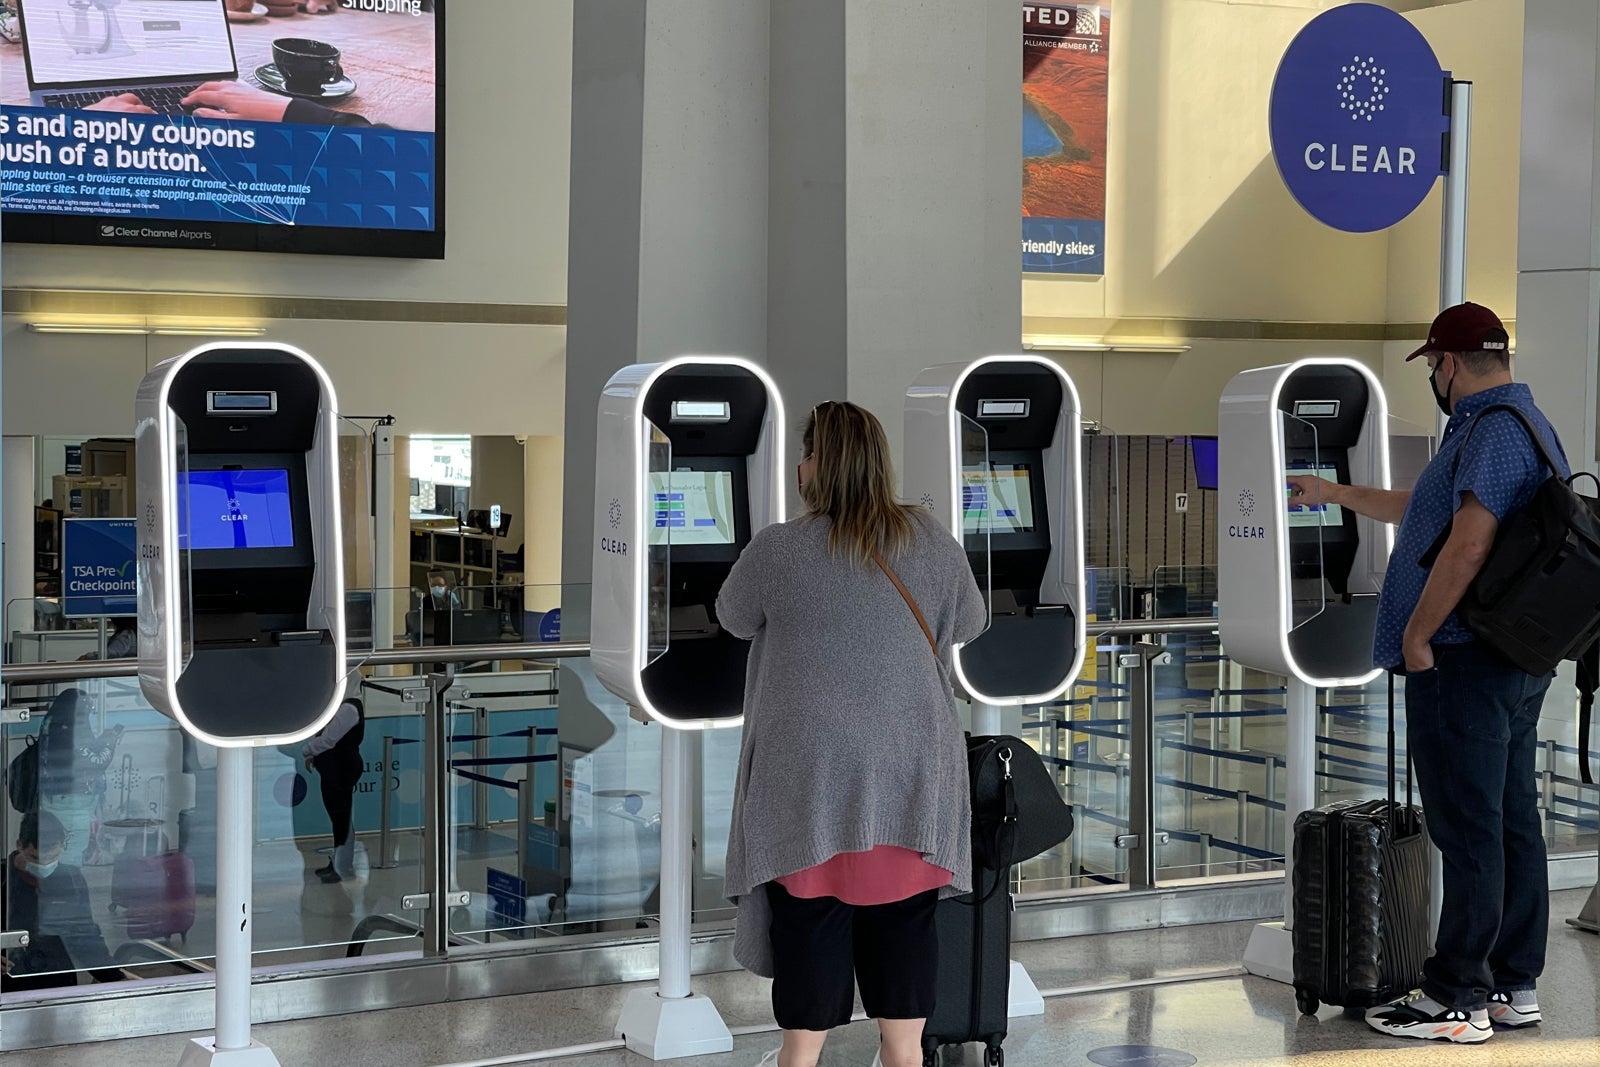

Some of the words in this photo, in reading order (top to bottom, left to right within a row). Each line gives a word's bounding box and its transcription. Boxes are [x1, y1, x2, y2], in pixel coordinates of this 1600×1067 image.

[1024, 40, 1057, 48] ALLIANCE
[1058, 42, 1087, 50] MEMBER
[17, 114, 66, 137] and
[73, 118, 146, 145] apply
[151, 124, 256, 150] coupons
[59, 143, 87, 165] of
[93, 148, 109, 167] a
[116, 145, 207, 172] button.
[1304, 142, 1416, 175] CLEAR
[33, 171, 66, 181] button
[77, 174, 85, 182] a
[86, 173, 126, 184] browser
[128, 176, 174, 186] extension
[175, 178, 190, 188] for
[191, 179, 228, 189] Chrome
[238, 181, 248, 190] to
[249, 182, 286, 193] activate
[287, 185, 312, 194] miles
[25, 183, 52, 193] store
[53, 184, 78, 195] sites.
[80, 185, 96, 195] For
[98, 186, 133, 198] details,
[135, 190, 151, 198] see
[152, 188, 306, 206] shopping.mileageplus.com/button
[115, 227, 140, 237] Clear
[140, 228, 178, 239] Channel
[179, 230, 212, 240] Airports
[1065, 241, 1095, 255] skies
[1177, 496, 1187, 507] 17
[1229, 525, 1265, 539] CLEAR
[142, 544, 160, 559] CLEAR
[601, 537, 627, 556] CLEAR
[72, 566, 94, 577] TSA
[96, 566, 116, 576] Pre
[69, 580, 136, 592] Checkpoint
[375, 760, 400, 773] ae
